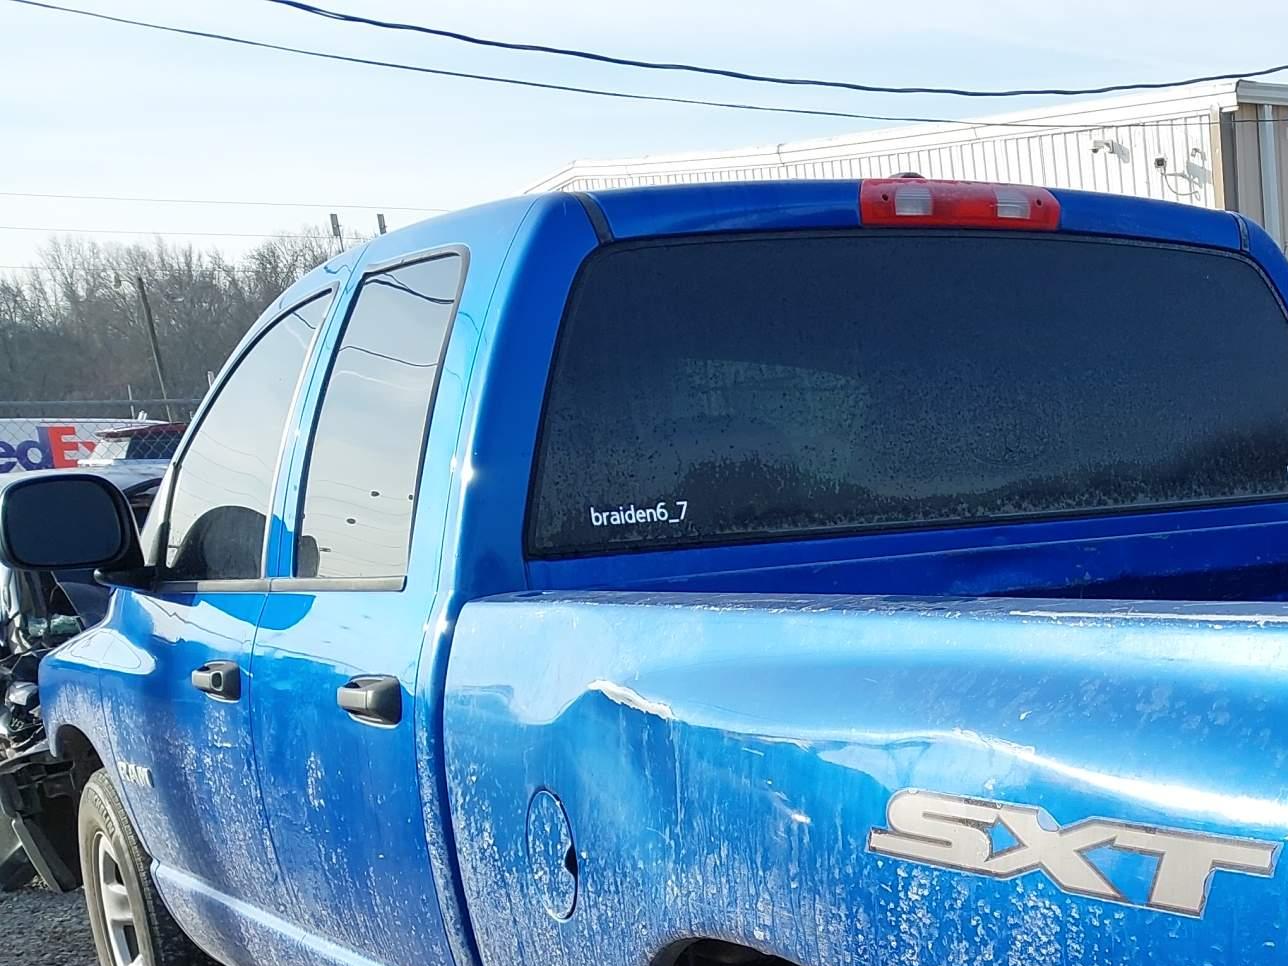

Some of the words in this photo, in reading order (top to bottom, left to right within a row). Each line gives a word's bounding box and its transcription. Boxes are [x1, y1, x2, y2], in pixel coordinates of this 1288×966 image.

[590, 501, 688, 526] braiden6_7
[117, 760, 154, 789] RAM
[868, 788, 1283, 918] SXT
